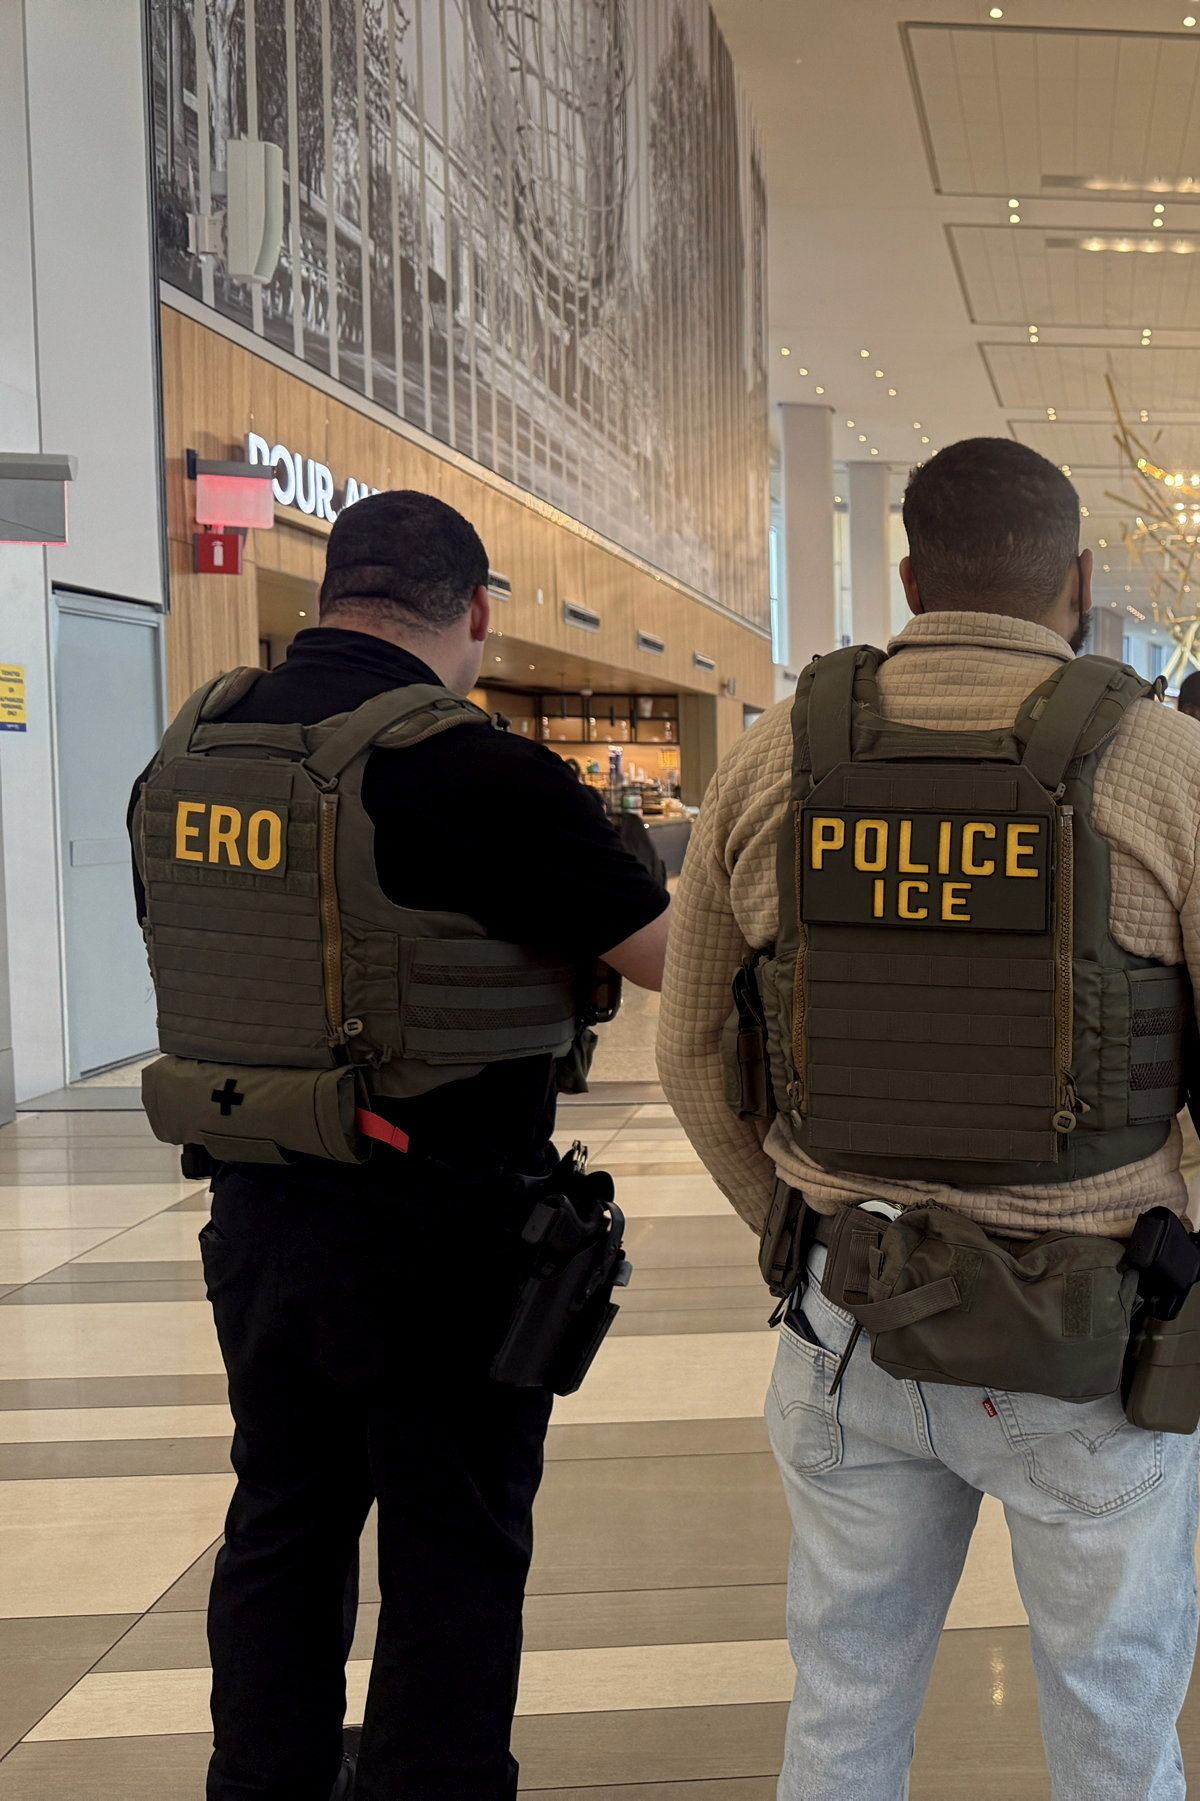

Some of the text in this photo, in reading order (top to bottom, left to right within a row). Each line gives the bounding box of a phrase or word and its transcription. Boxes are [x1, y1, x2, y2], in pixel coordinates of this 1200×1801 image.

[175, 801, 282, 870] ERO
[811, 816, 1040, 877] POLICE
[873, 879, 972, 921] ICE
